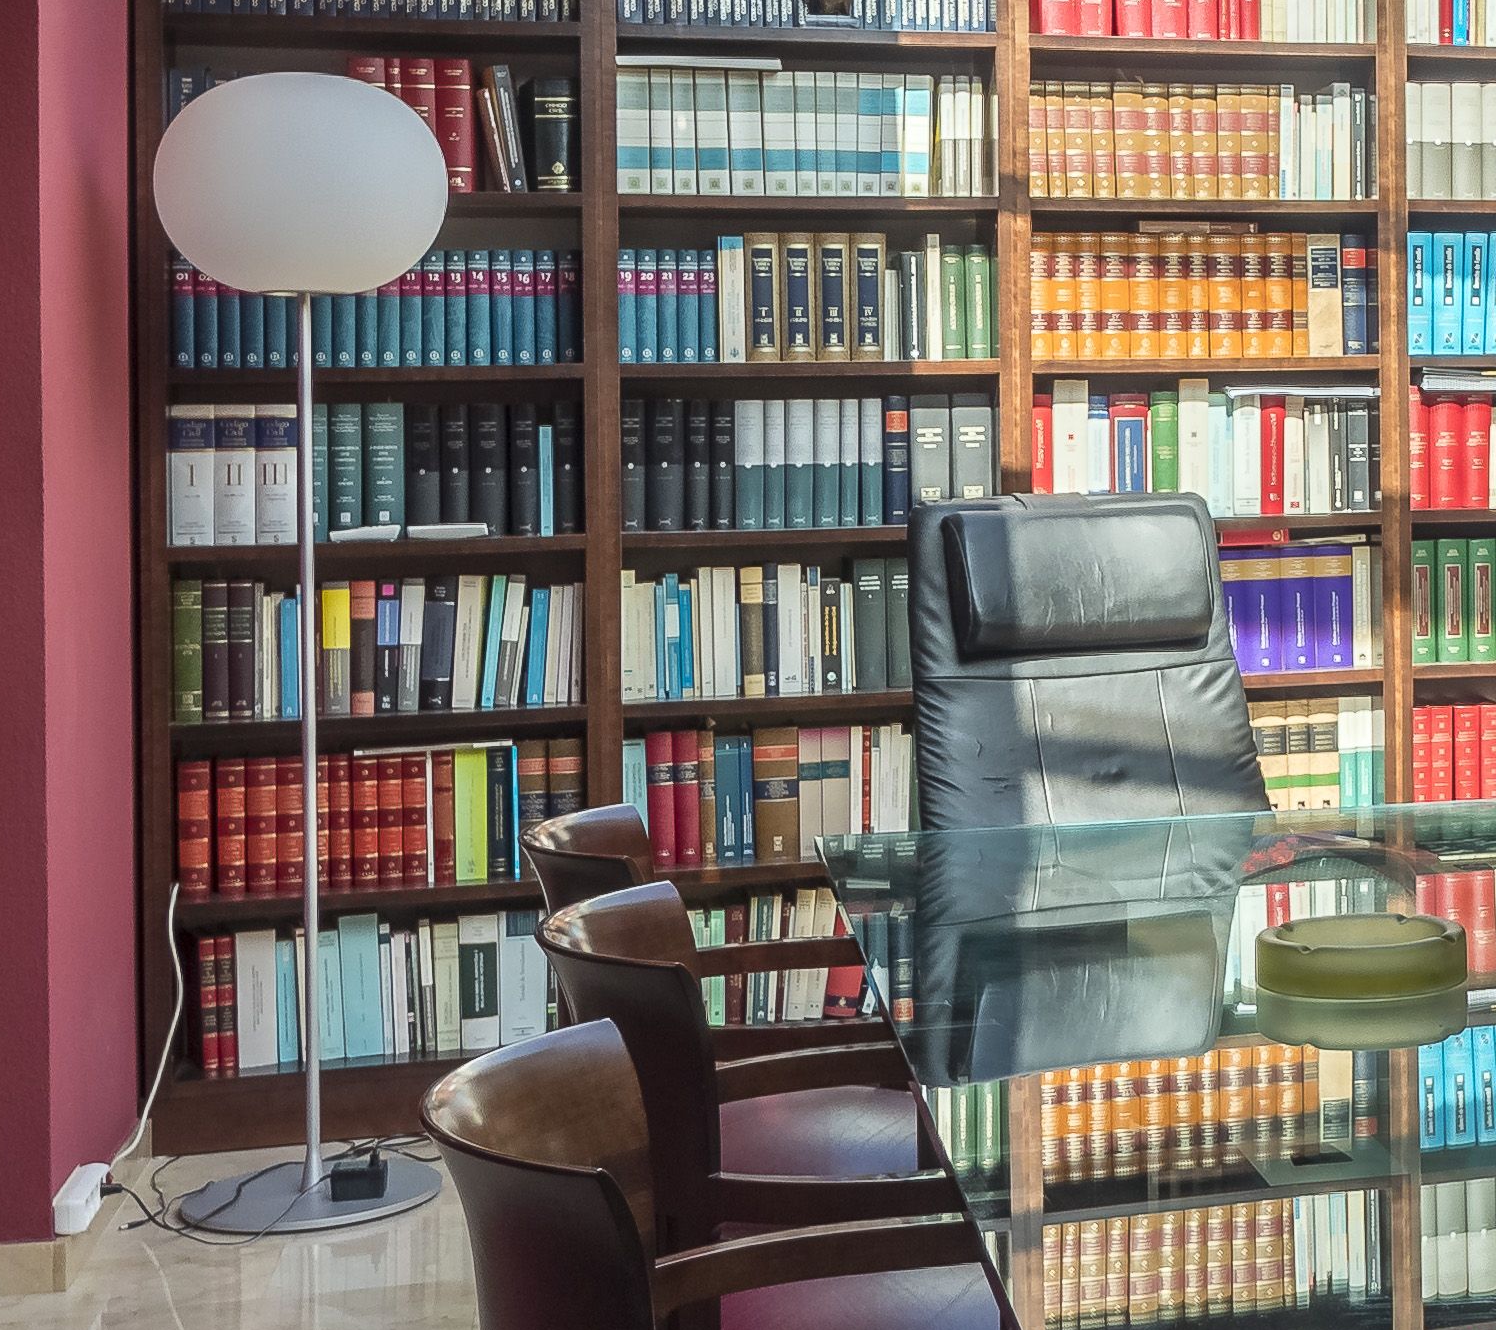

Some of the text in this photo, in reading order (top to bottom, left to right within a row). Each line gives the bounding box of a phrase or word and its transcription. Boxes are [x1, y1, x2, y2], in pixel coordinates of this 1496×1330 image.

[176, 272, 189, 281] 01
[405, 272, 416, 281] 11
[428, 273, 440, 282] 12
[450, 272, 461, 283] 13
[472, 271, 484, 282] 14
[496, 272, 508, 283] 15
[517, 273, 530, 283] 16
[540, 272, 552, 282] 17
[563, 271, 575, 282] 18
[619, 271, 633, 282] 19
[640, 272, 654, 281] 20
[661, 271, 673, 281] 21
[681, 271, 695, 281] 22
[702, 271, 715, 282] 23
